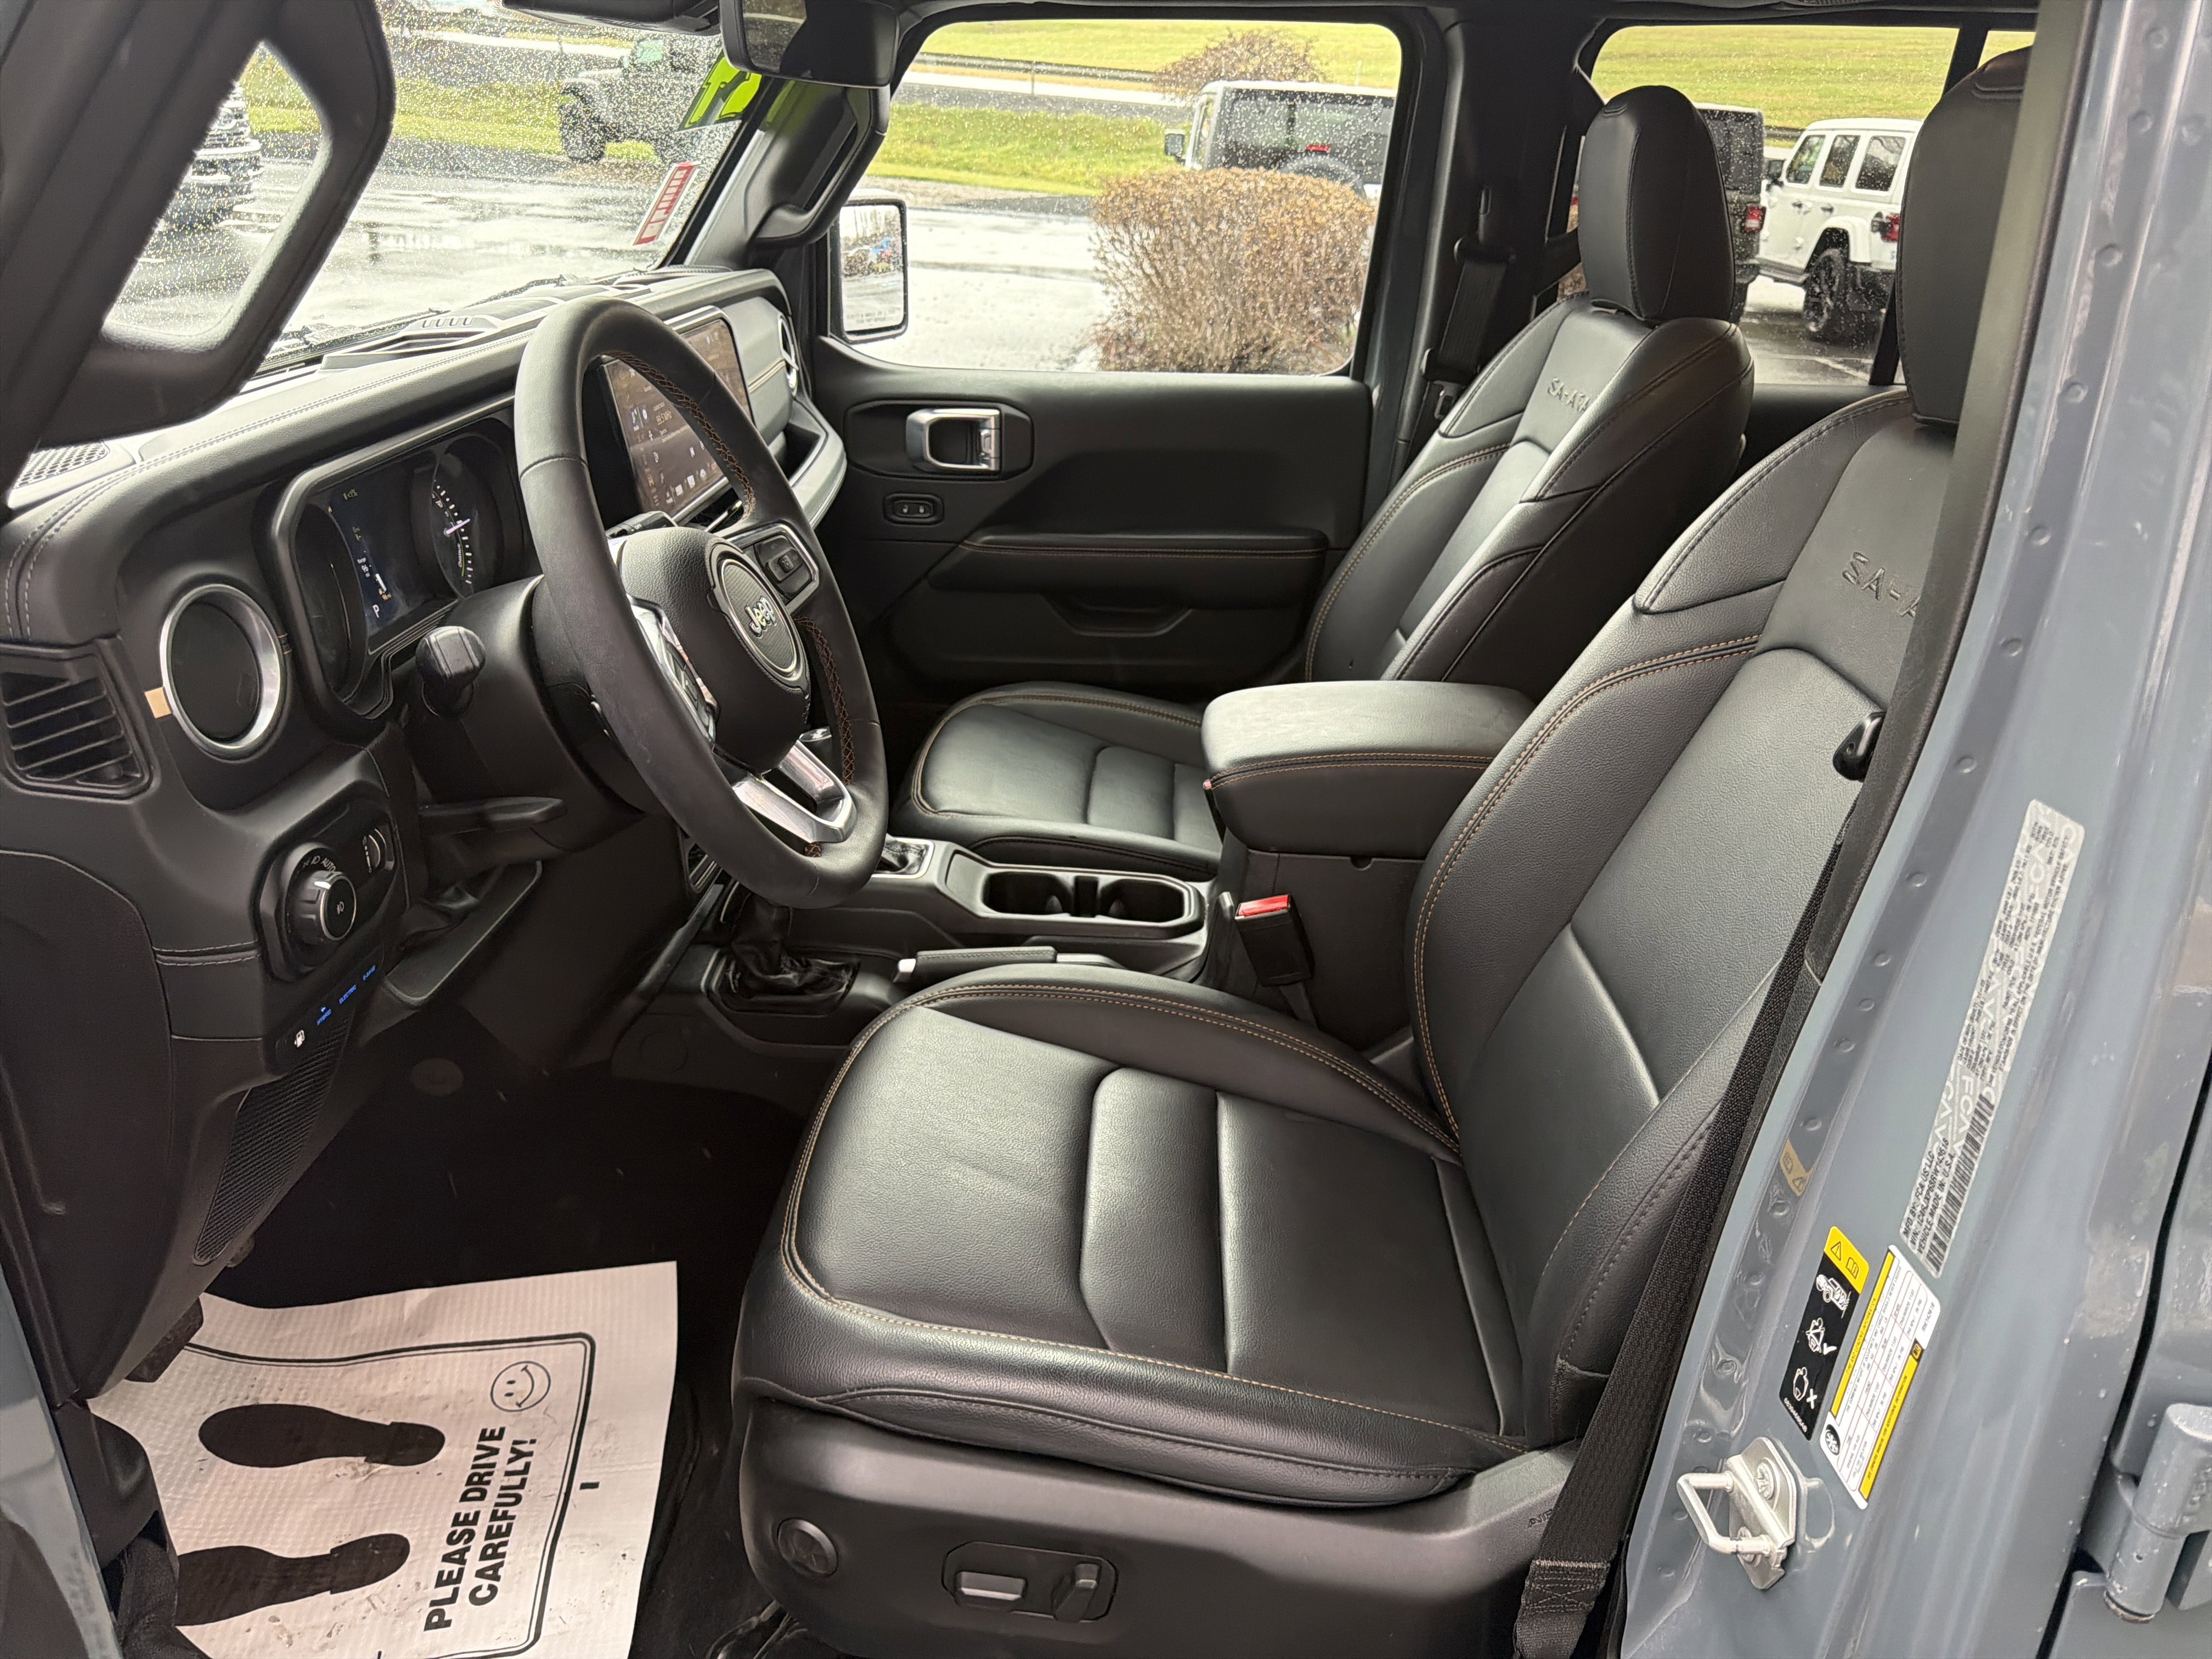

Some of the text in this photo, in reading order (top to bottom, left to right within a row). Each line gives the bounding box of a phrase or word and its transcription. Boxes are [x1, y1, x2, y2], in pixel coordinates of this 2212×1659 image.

[373, 605, 380, 618] P
[744, 596, 777, 637] Jeep
[320, 857, 337, 873] AUTO
[1915, 1180, 1925, 1201] FCA
[1920, 1166, 1929, 1183] US
[1925, 1149, 1935, 1170] LLC
[1917, 1216, 1933, 1256] VEHICLE
[1928, 1190, 1942, 1220] MADE
[424, 1426, 506, 1632] PLEASE DRIVE
[469, 1438, 537, 1606] CAREFULLY!
